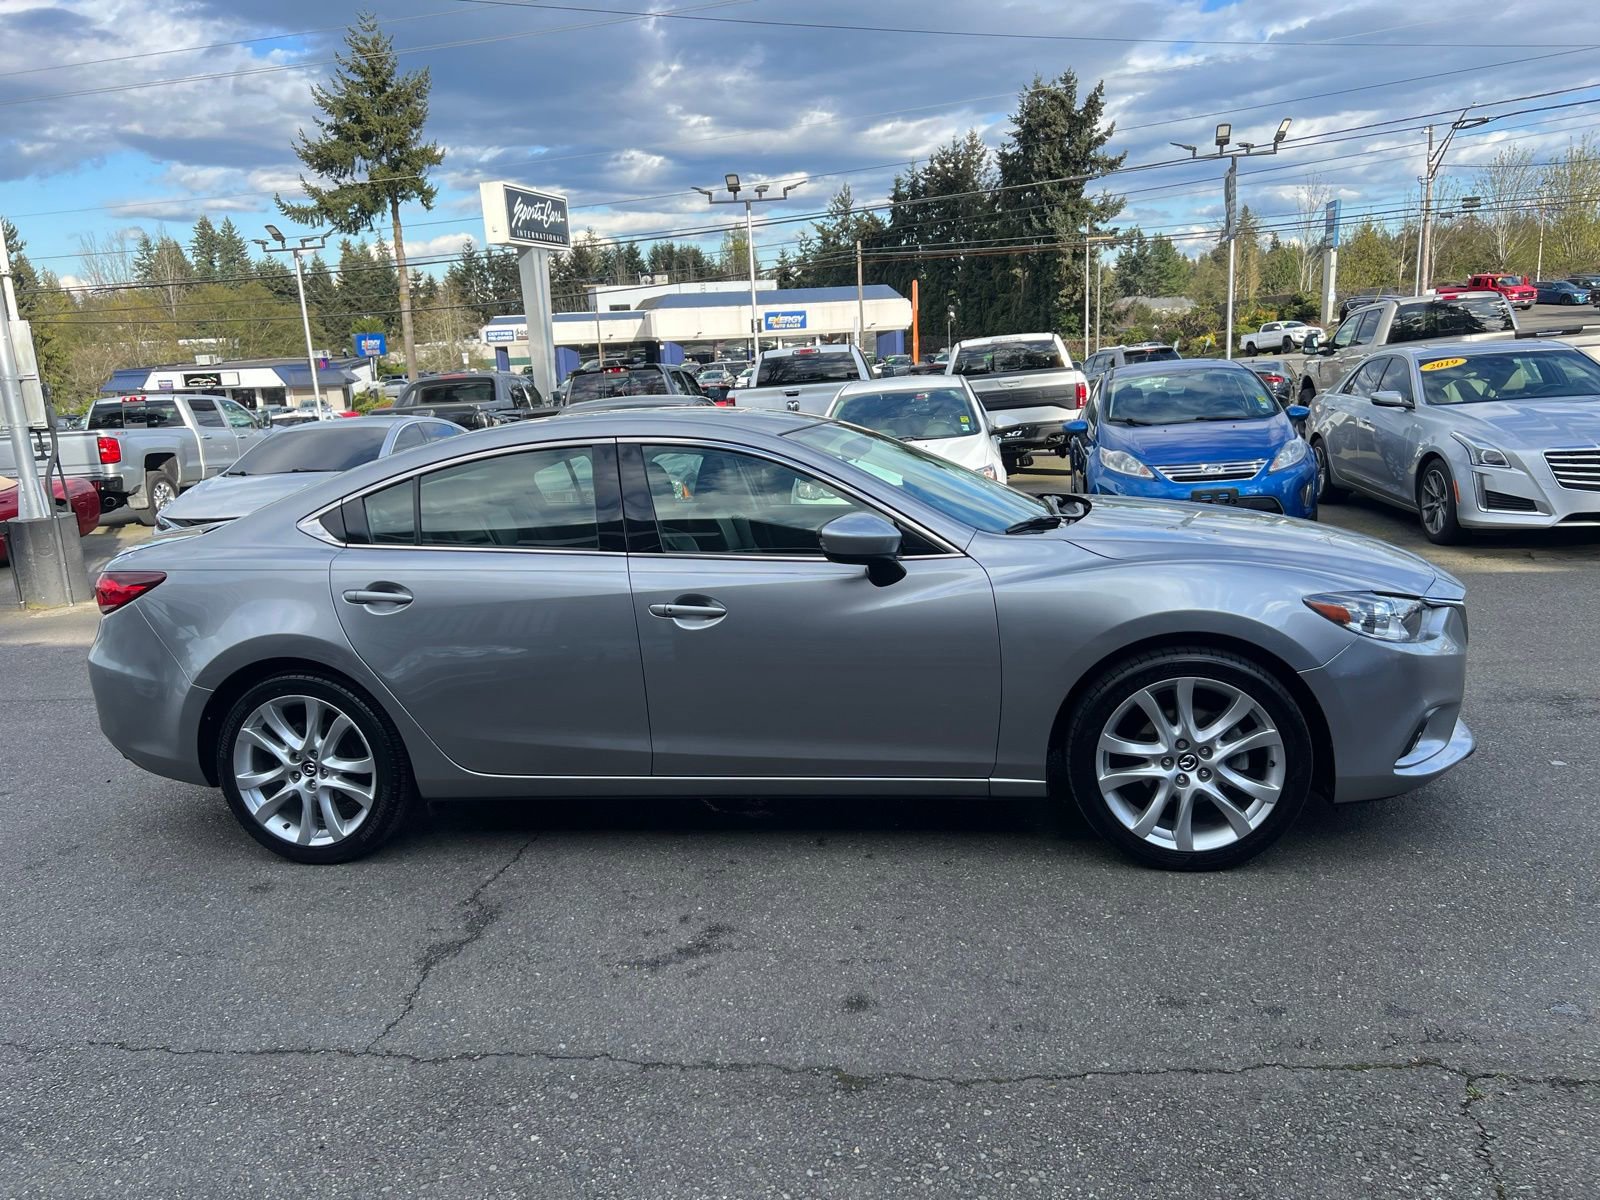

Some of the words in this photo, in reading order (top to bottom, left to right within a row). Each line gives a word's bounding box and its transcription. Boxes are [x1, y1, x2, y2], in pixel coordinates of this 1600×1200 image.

[511, 196, 545, 229] Sports
[543, 200, 565, 229] Cars
[516, 229, 563, 243] INTERNATIONAL
[1429, 359, 1458, 370] 2019
